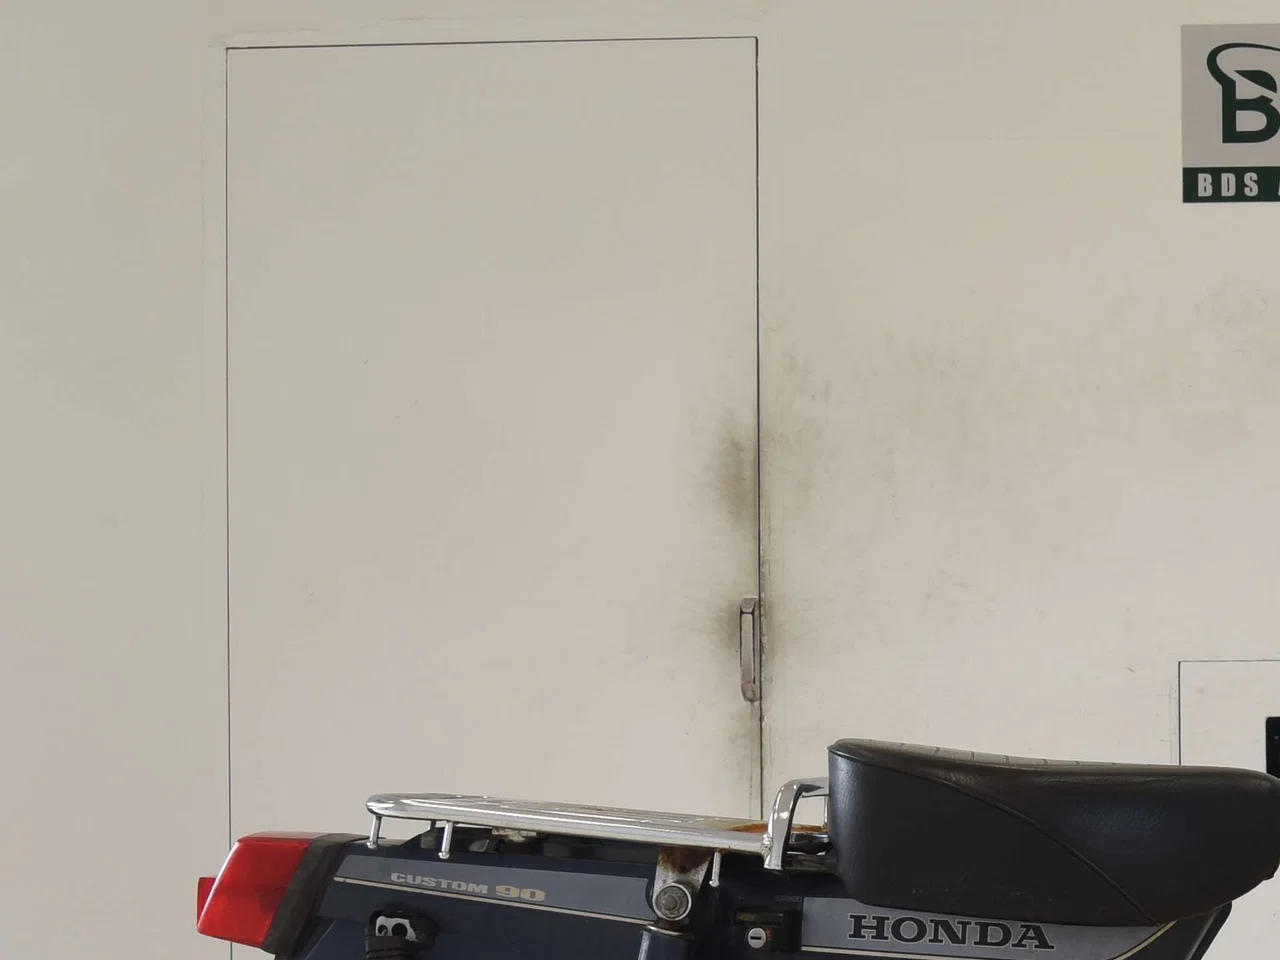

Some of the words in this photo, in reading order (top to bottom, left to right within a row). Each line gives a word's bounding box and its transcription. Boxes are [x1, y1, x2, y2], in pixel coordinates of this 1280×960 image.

[1197, 173, 1259, 197] BDS
[390, 872, 488, 894] CUSTOM
[495, 884, 546, 902] 90
[847, 912, 1055, 951] HONDA
